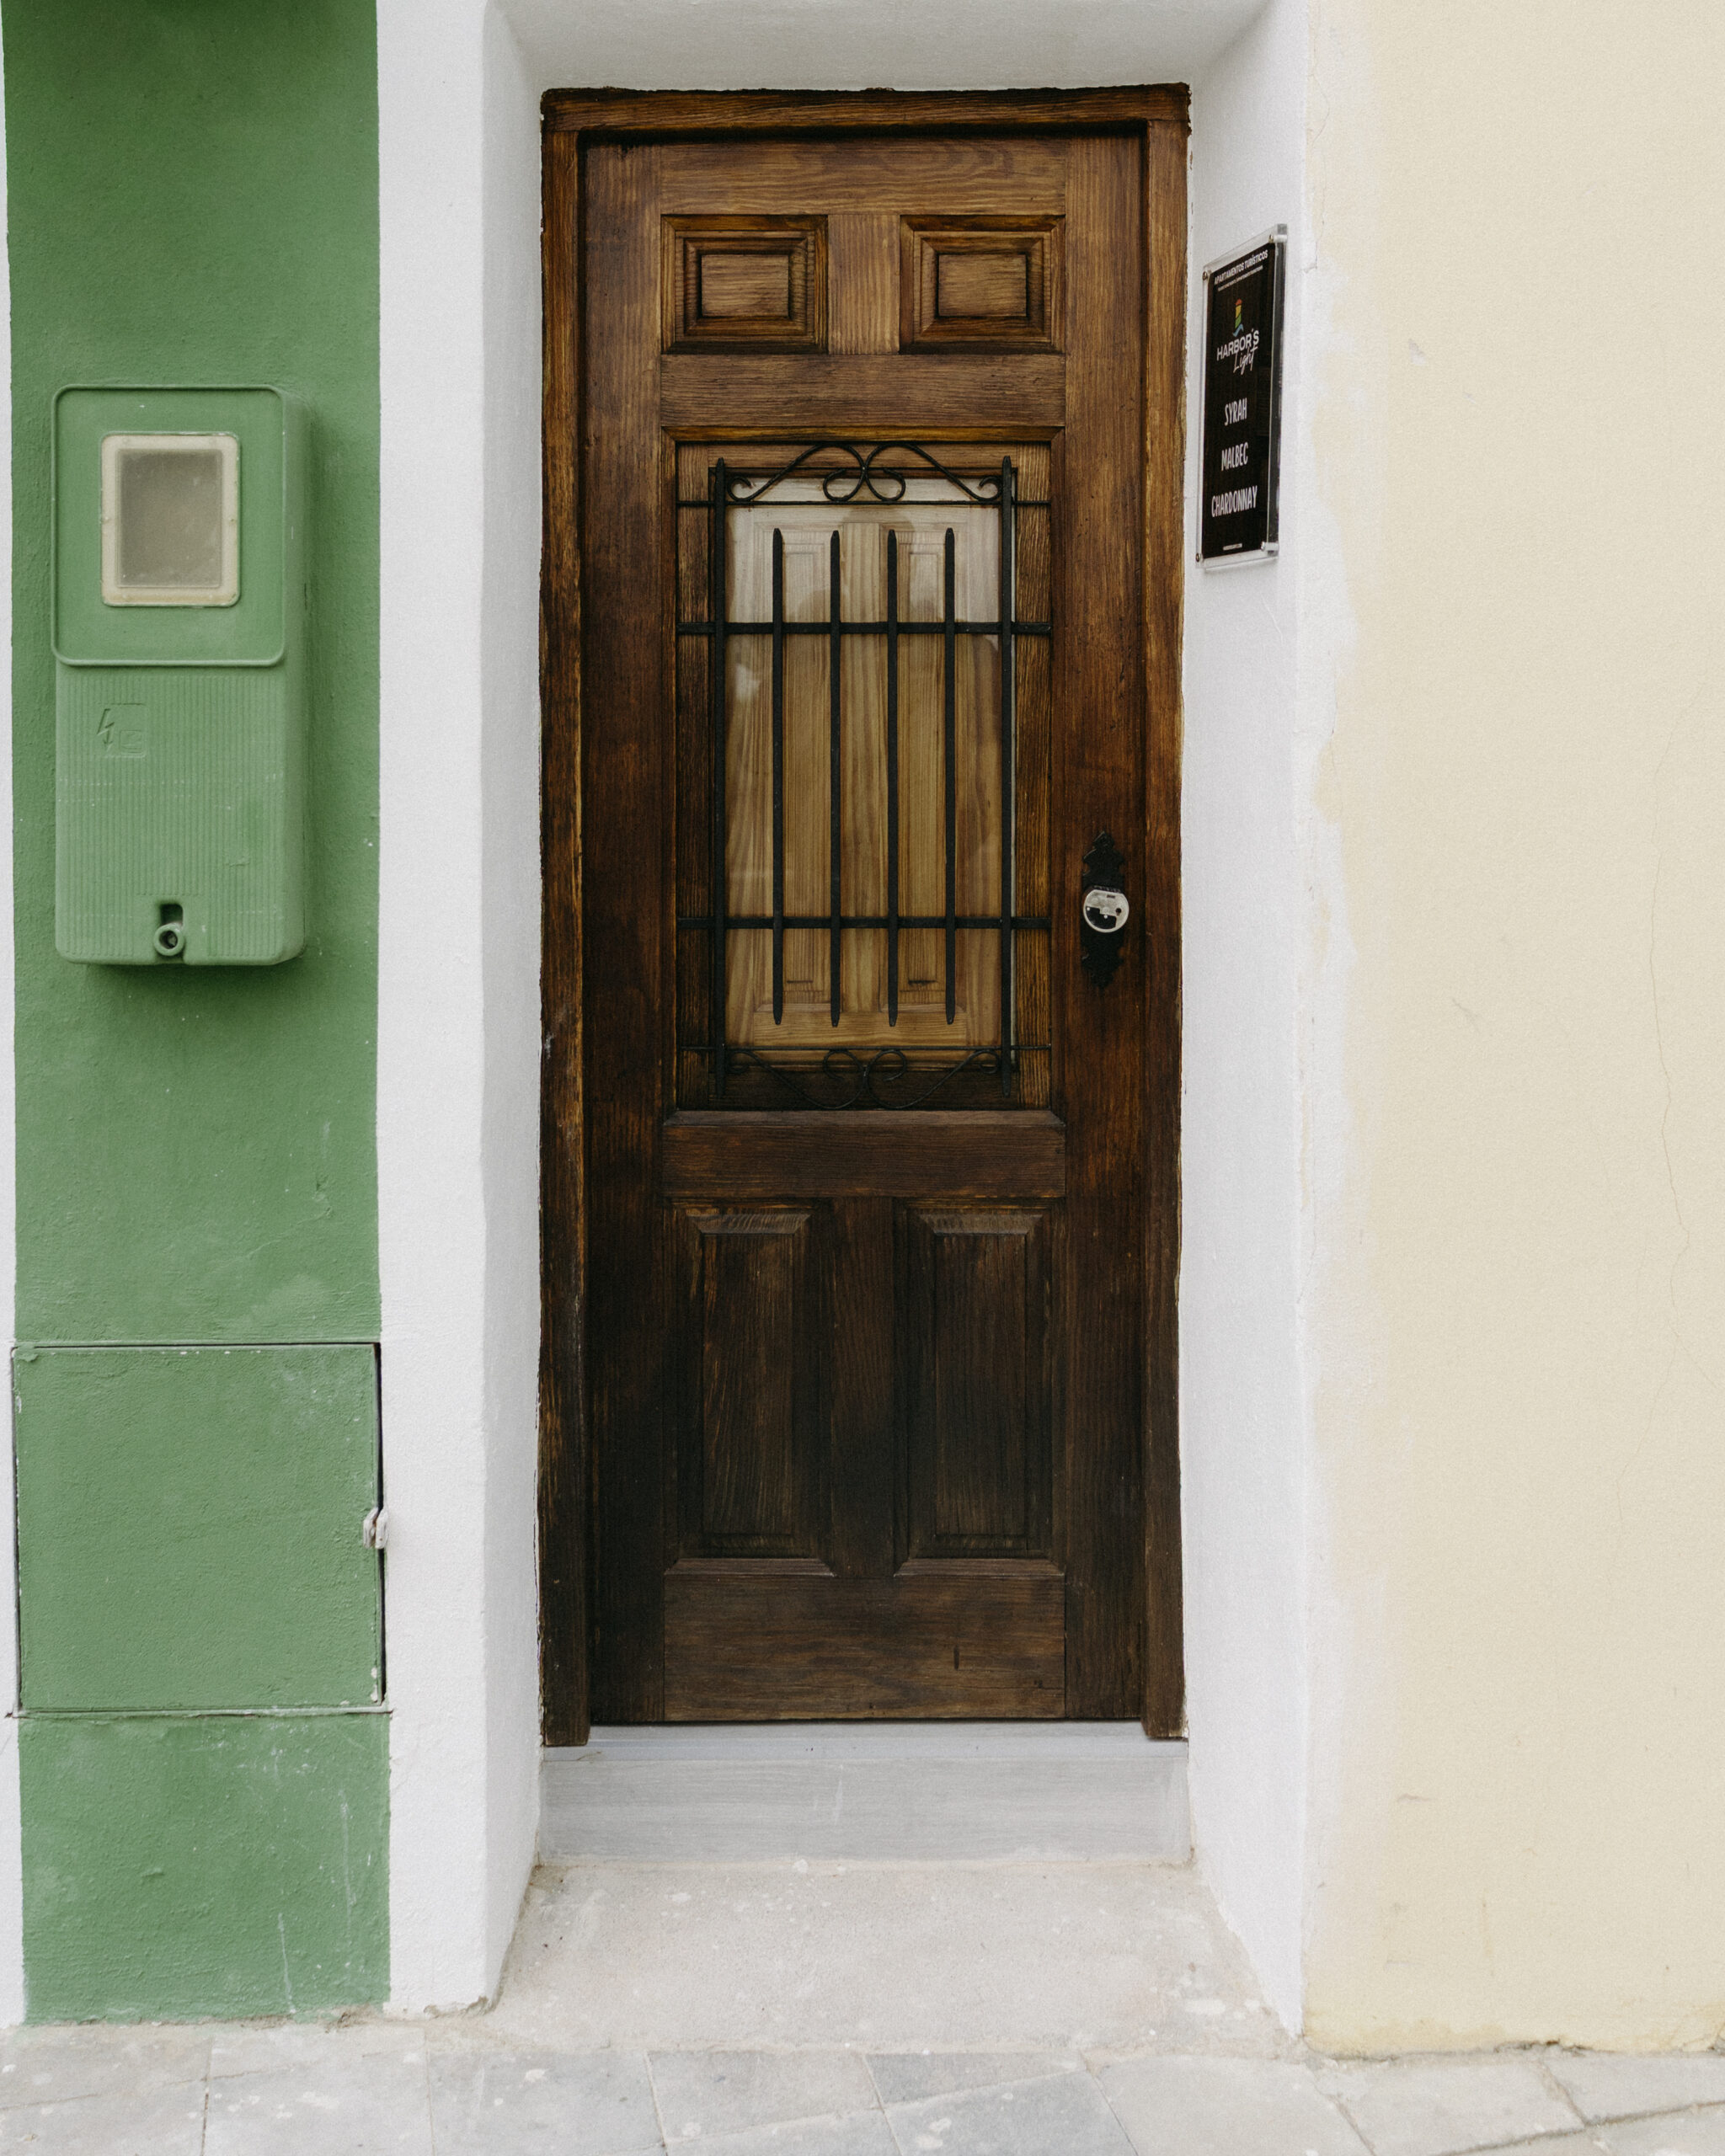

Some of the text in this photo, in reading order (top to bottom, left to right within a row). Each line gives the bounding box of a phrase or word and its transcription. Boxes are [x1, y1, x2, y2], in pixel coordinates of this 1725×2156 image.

[1216, 328, 1259, 361] HARBOR'S
[1233, 345, 1258, 376] Light
[1224, 398, 1247, 426] SYRAH
[1221, 441, 1248, 472] MALBEC
[1211, 485, 1258, 518] CHARDONNAY
